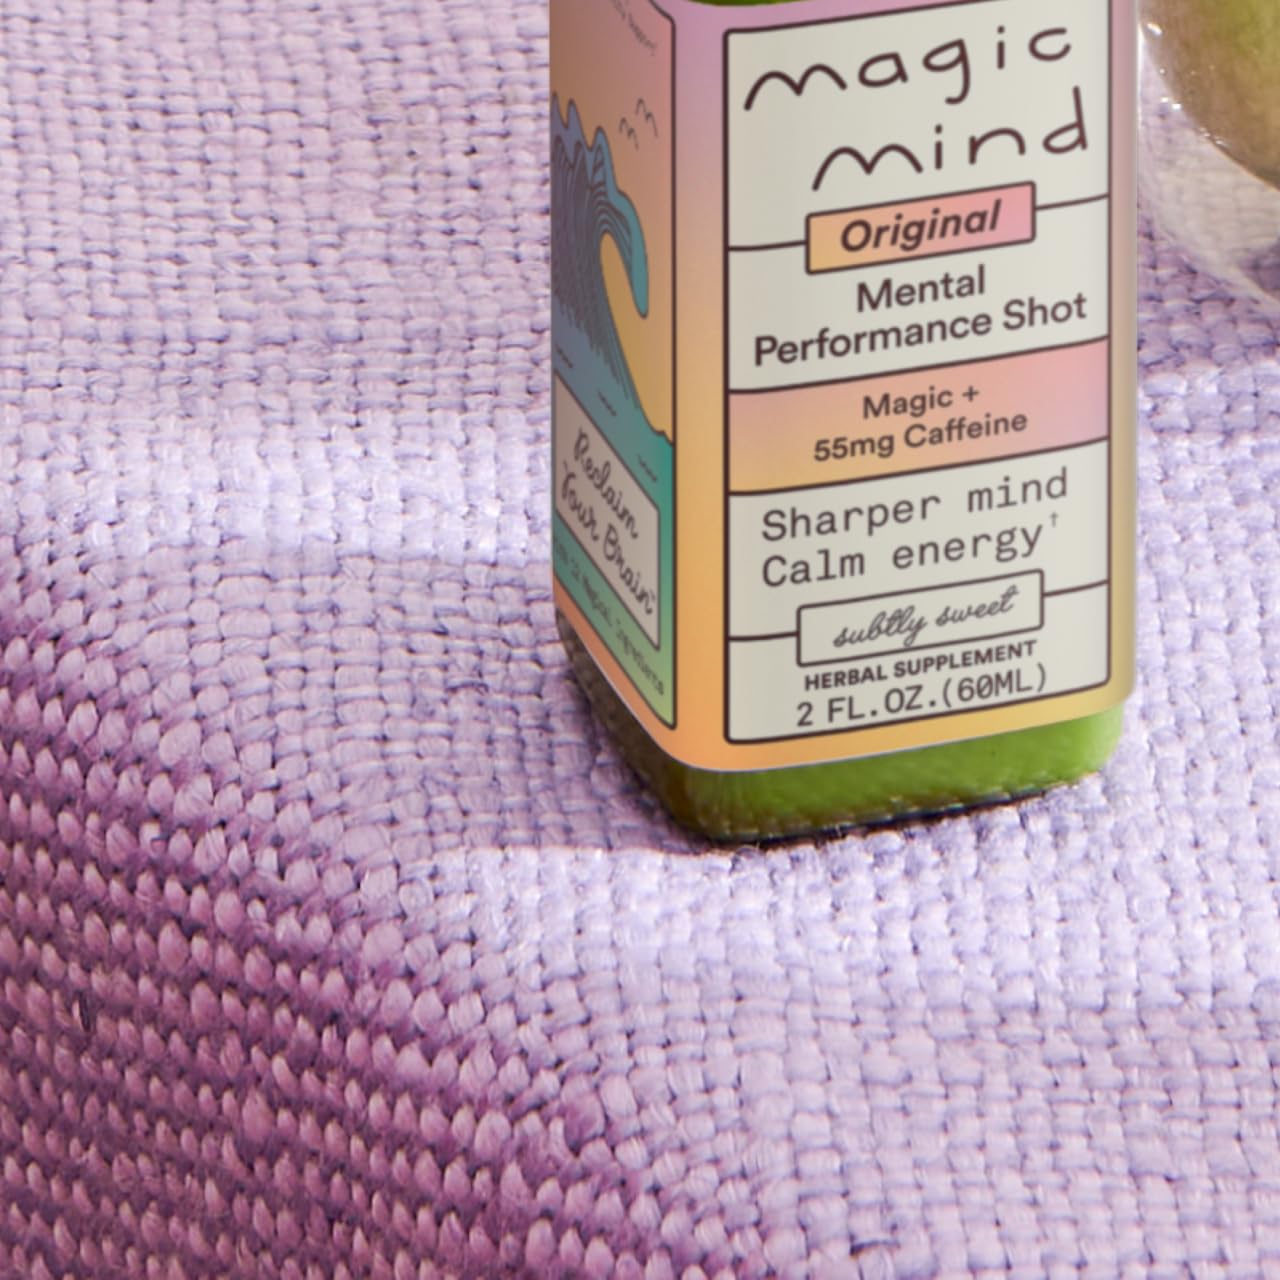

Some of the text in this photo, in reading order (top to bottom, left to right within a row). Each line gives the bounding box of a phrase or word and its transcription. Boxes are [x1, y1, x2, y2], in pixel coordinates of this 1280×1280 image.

[744, 26, 1071, 111] magic
[812, 86, 1088, 192] mind
[841, 198, 1002, 253] Original
[857, 264, 986, 313] Mental
[754, 293, 1087, 367] Performance Shot
[863, 386, 954, 420] Magic
[813, 412, 1029, 462] 55mg Caffeine
[561, 459, 600, 542] Your
[573, 426, 639, 540] Reclaim
[762, 466, 1068, 543] Sharper mind
[762, 549, 866, 588] Calm
[832, 585, 1019, 649] subtly sweet
[804, 640, 1038, 692] HERBAL SUPPLEMENT
[796, 701, 814, 727] 2
